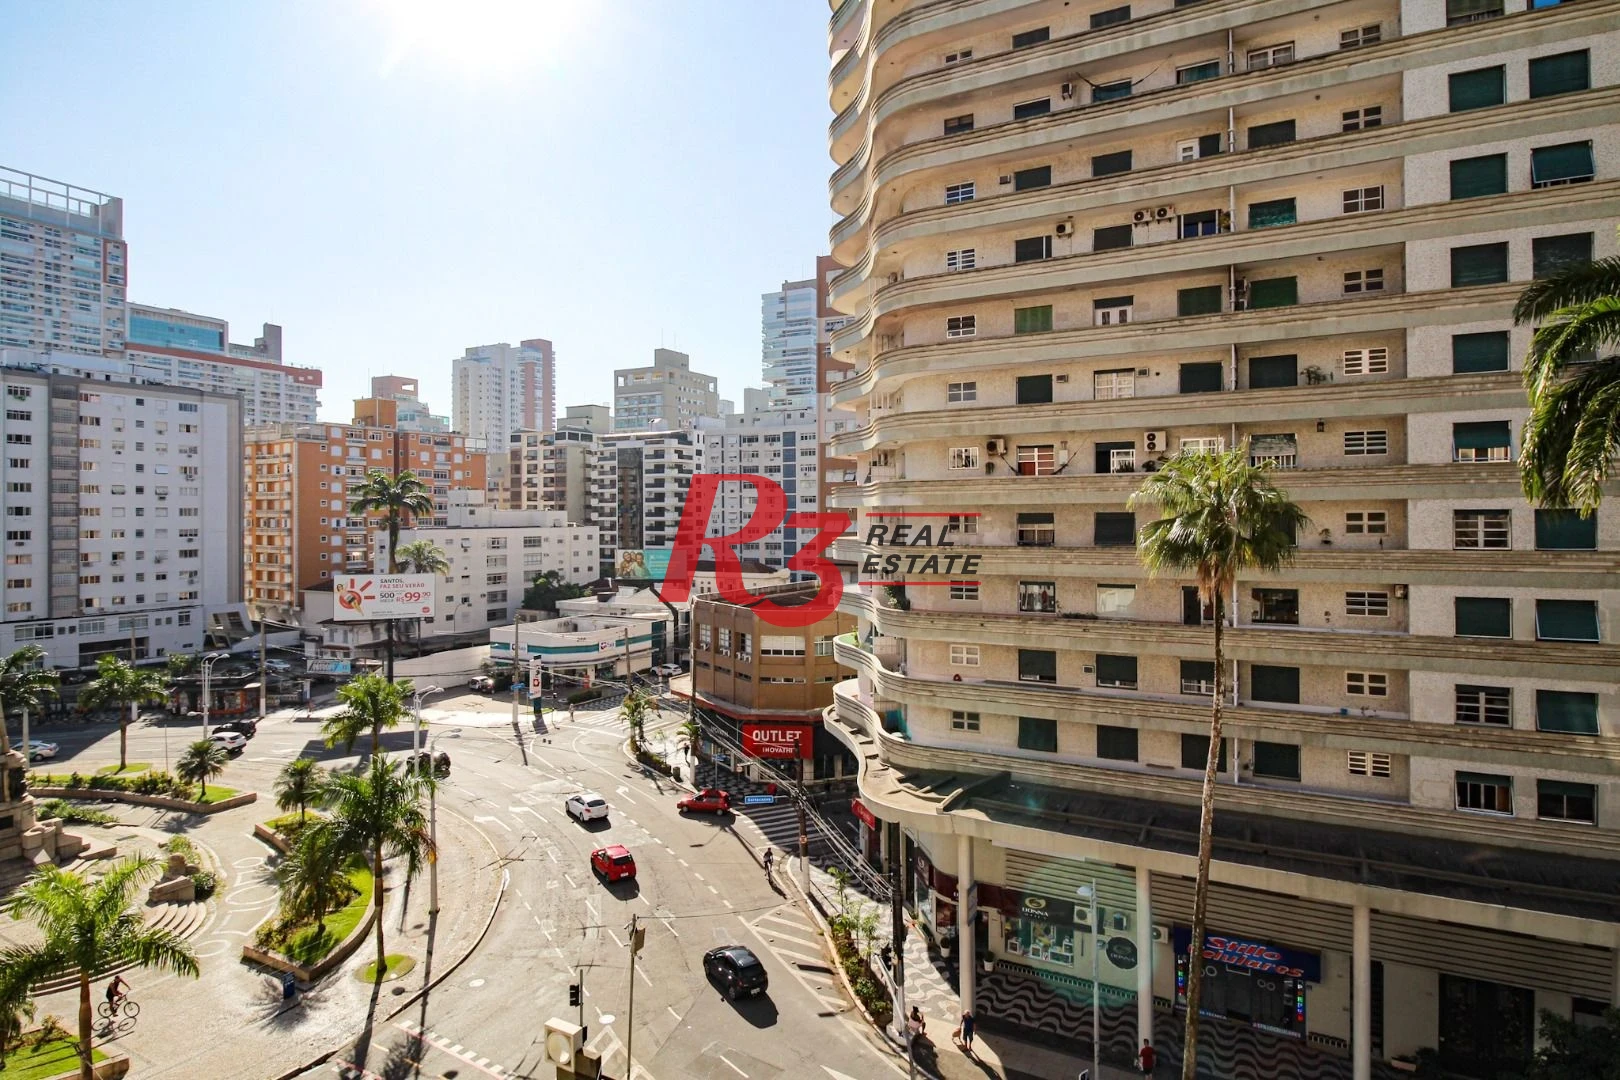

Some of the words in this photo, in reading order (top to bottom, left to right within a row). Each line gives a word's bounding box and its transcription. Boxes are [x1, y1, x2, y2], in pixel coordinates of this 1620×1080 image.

[752, 730, 802, 742] OUTLET
[1021, 907, 1049, 917] DONNA
[1206, 936, 1282, 961] Stillo
